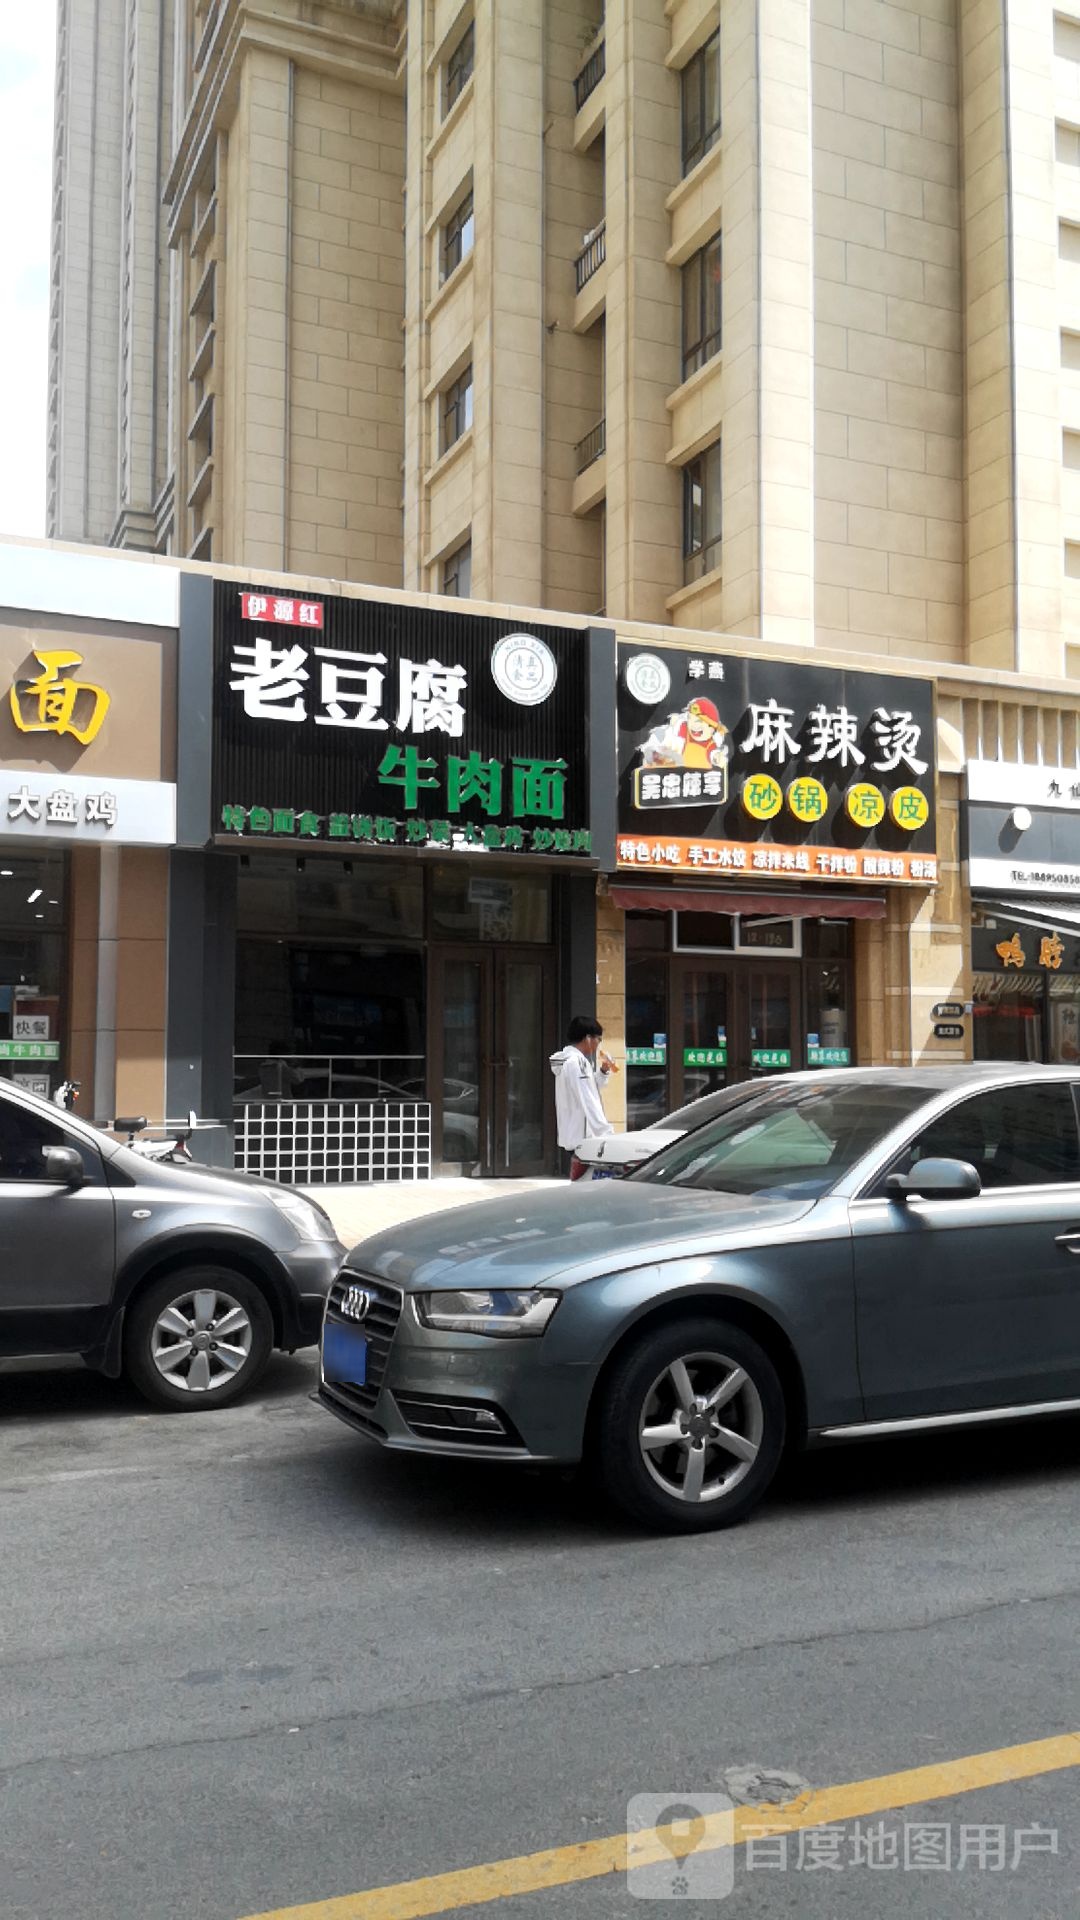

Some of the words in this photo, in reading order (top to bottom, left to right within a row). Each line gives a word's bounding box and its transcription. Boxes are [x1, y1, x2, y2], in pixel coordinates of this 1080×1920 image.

[10, 649, 111, 745] 面
[230, 637, 467, 737] 老豆腐
[739, 698, 929, 776] 麻辣烫
[377, 744, 567, 819] 牛肉面
[748, 781, 822, 817] 砂锅
[852, 790, 923, 822] 凉皮
[8, 784, 117, 829] 大盘鸡
[222, 804, 320, 836] 特色面食
[620, 840, 681, 864] 特色小吃
[688, 844, 746, 867] 手工水饺
[752, 849, 810, 871] 凉拌米线
[816, 853, 857, 874] 干拌粉
[16, 1020, 46, 1035] 快餐
[687, 1051, 724, 1064] 欢迎光临
